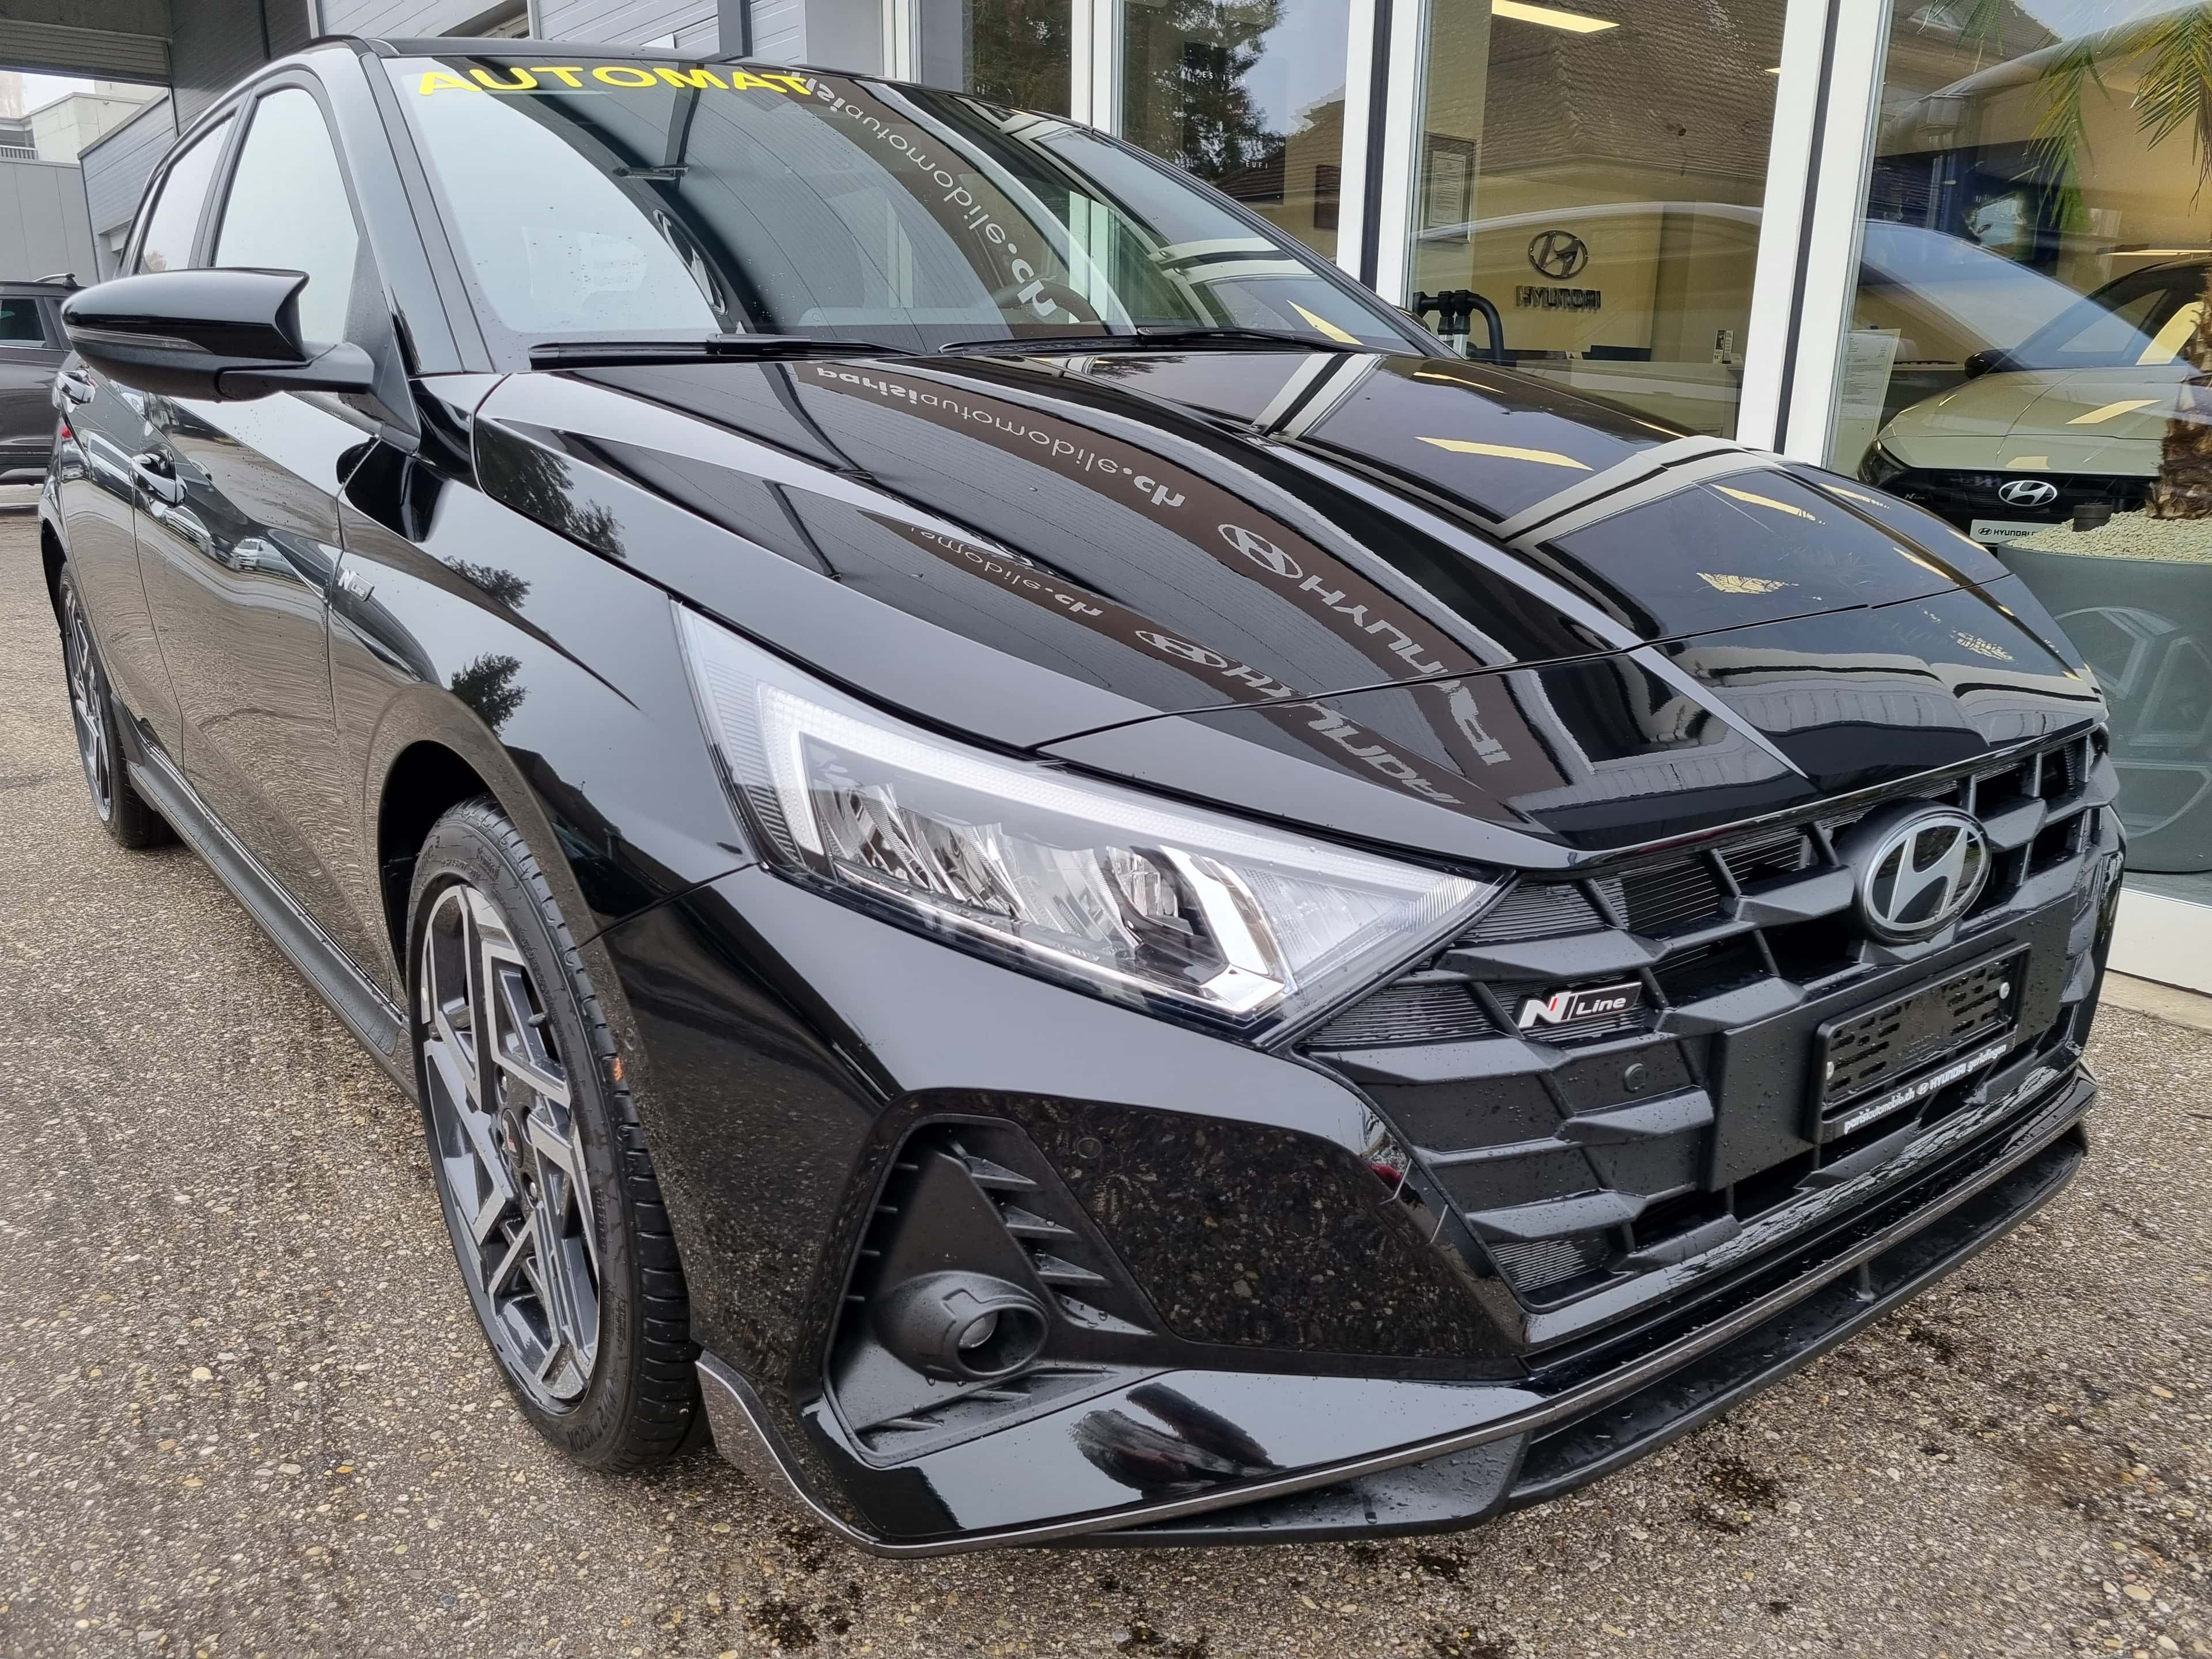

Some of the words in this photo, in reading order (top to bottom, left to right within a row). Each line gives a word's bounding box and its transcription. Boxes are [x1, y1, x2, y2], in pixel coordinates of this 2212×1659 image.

[419, 66, 812, 96] AUTOMAT
[1516, 285, 1601, 309] HYUNDAI
[1518, 991, 1571, 1028] N
[1575, 997, 1627, 1016] Line
[1929, 1062, 1967, 1090] HYUNDAI
